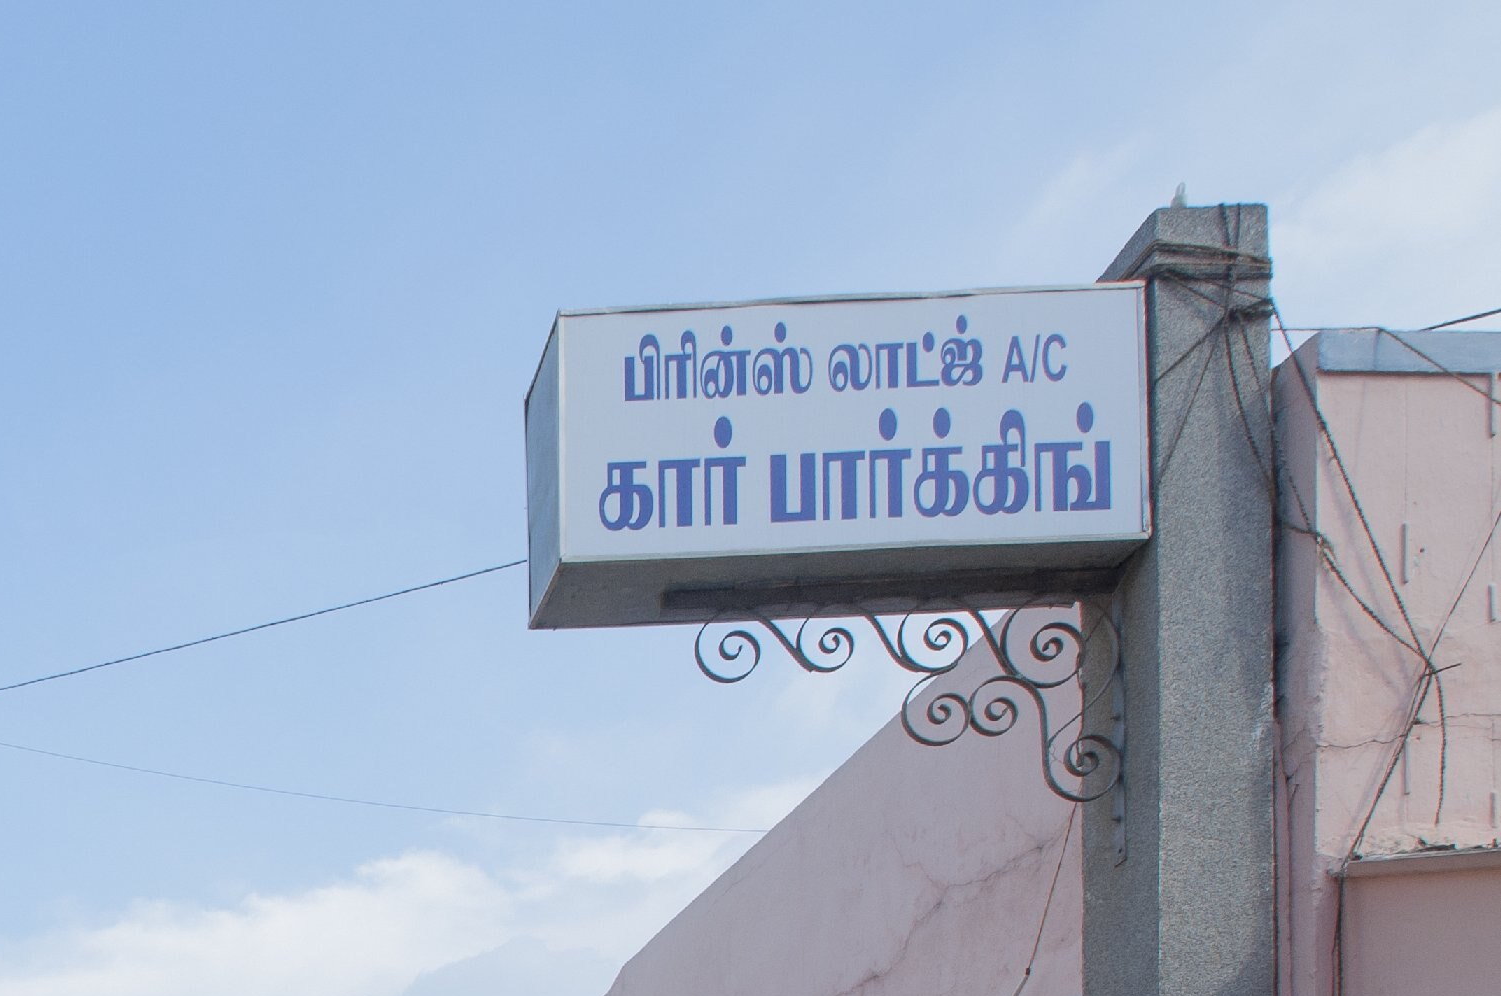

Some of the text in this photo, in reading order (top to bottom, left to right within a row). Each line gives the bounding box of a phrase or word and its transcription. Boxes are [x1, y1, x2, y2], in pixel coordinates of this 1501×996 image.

[624, 314, 1068, 402] பிரின்ஸ் லாட்ஜ் A/C
[599, 402, 1113, 531] கார் பார்க்கிங்
